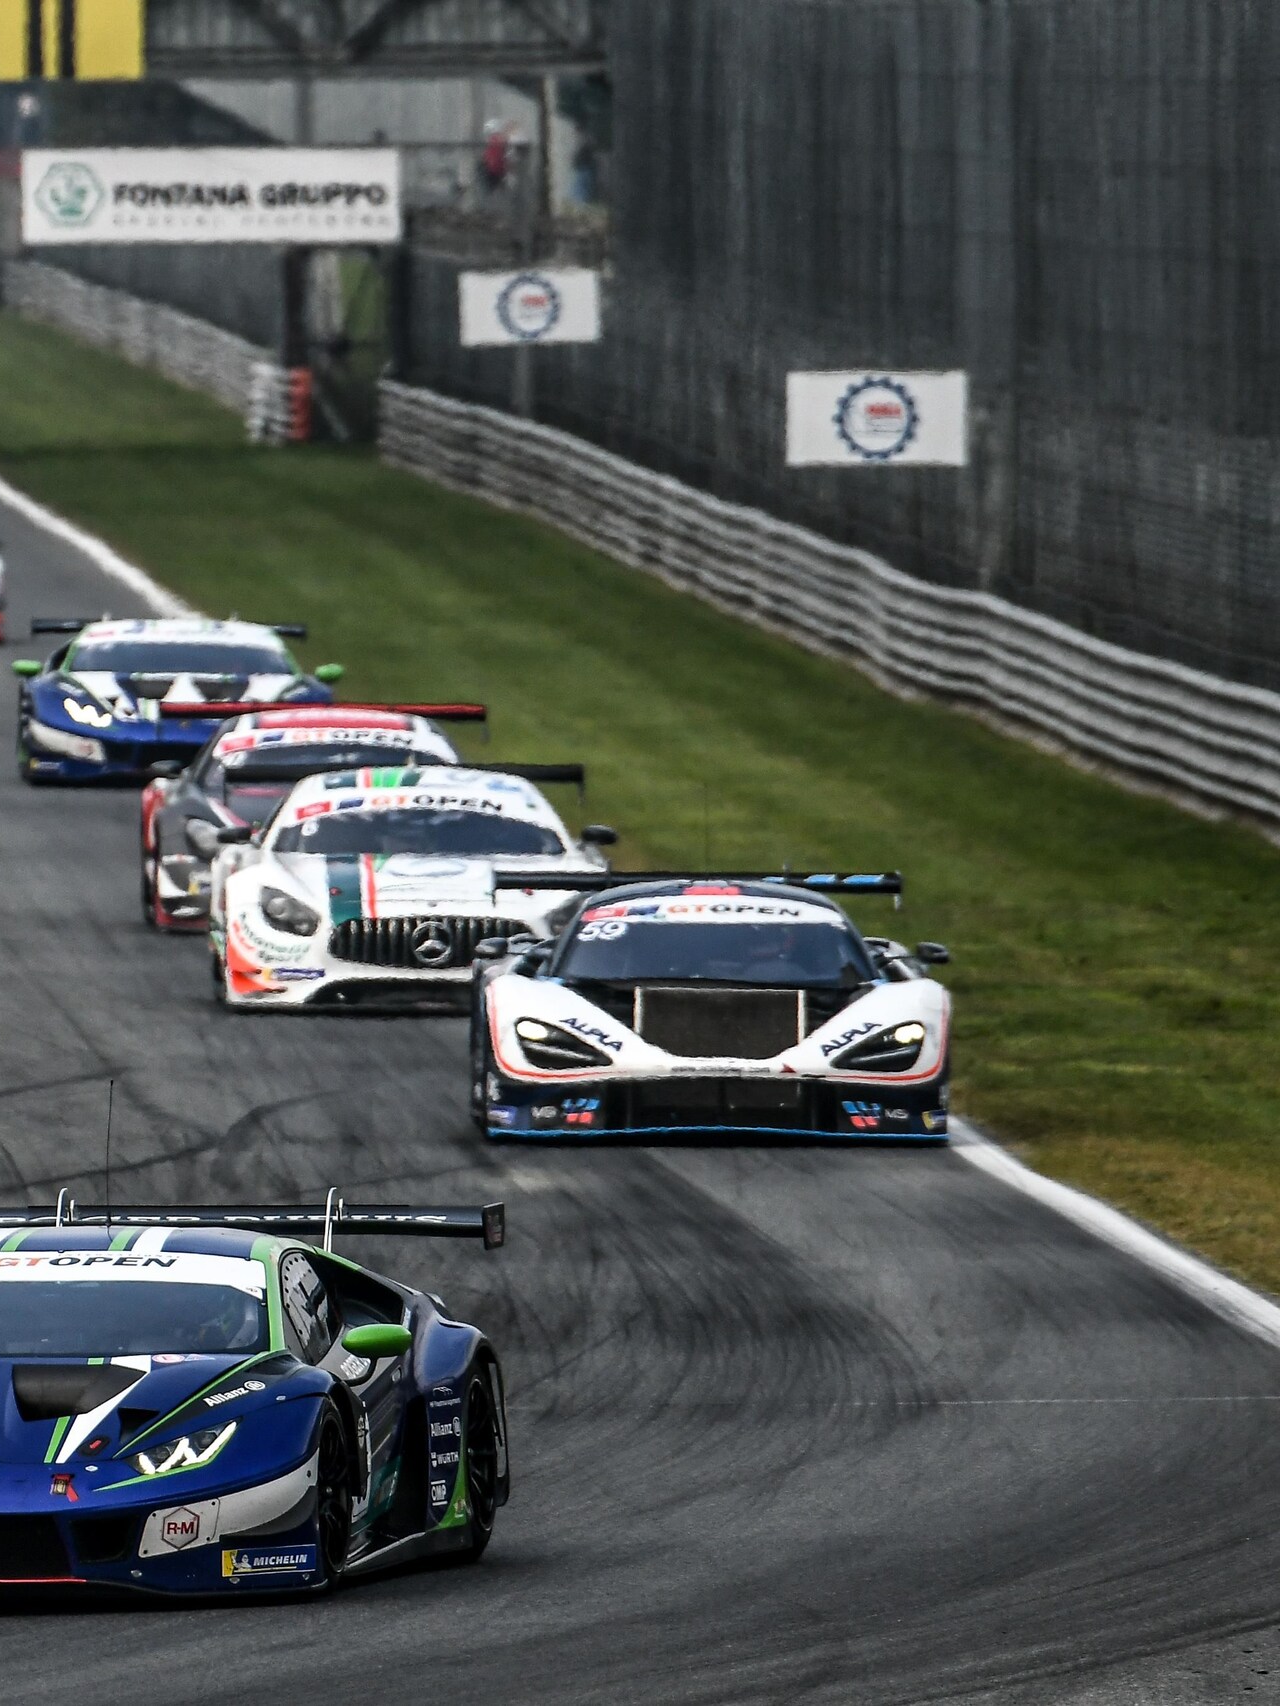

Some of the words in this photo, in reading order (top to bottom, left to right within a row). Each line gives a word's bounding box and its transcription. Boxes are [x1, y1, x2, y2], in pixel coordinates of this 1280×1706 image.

[113, 182, 251, 209] FONTANA
[259, 182, 387, 209] GRUPPO
[577, 921, 629, 942] 59
[820, 1021, 883, 1057] ALPLA
[202, 1386, 250, 1407] Allianz
[166, 1521, 195, 1535] R-M
[253, 1554, 309, 1567] MICHELIN
